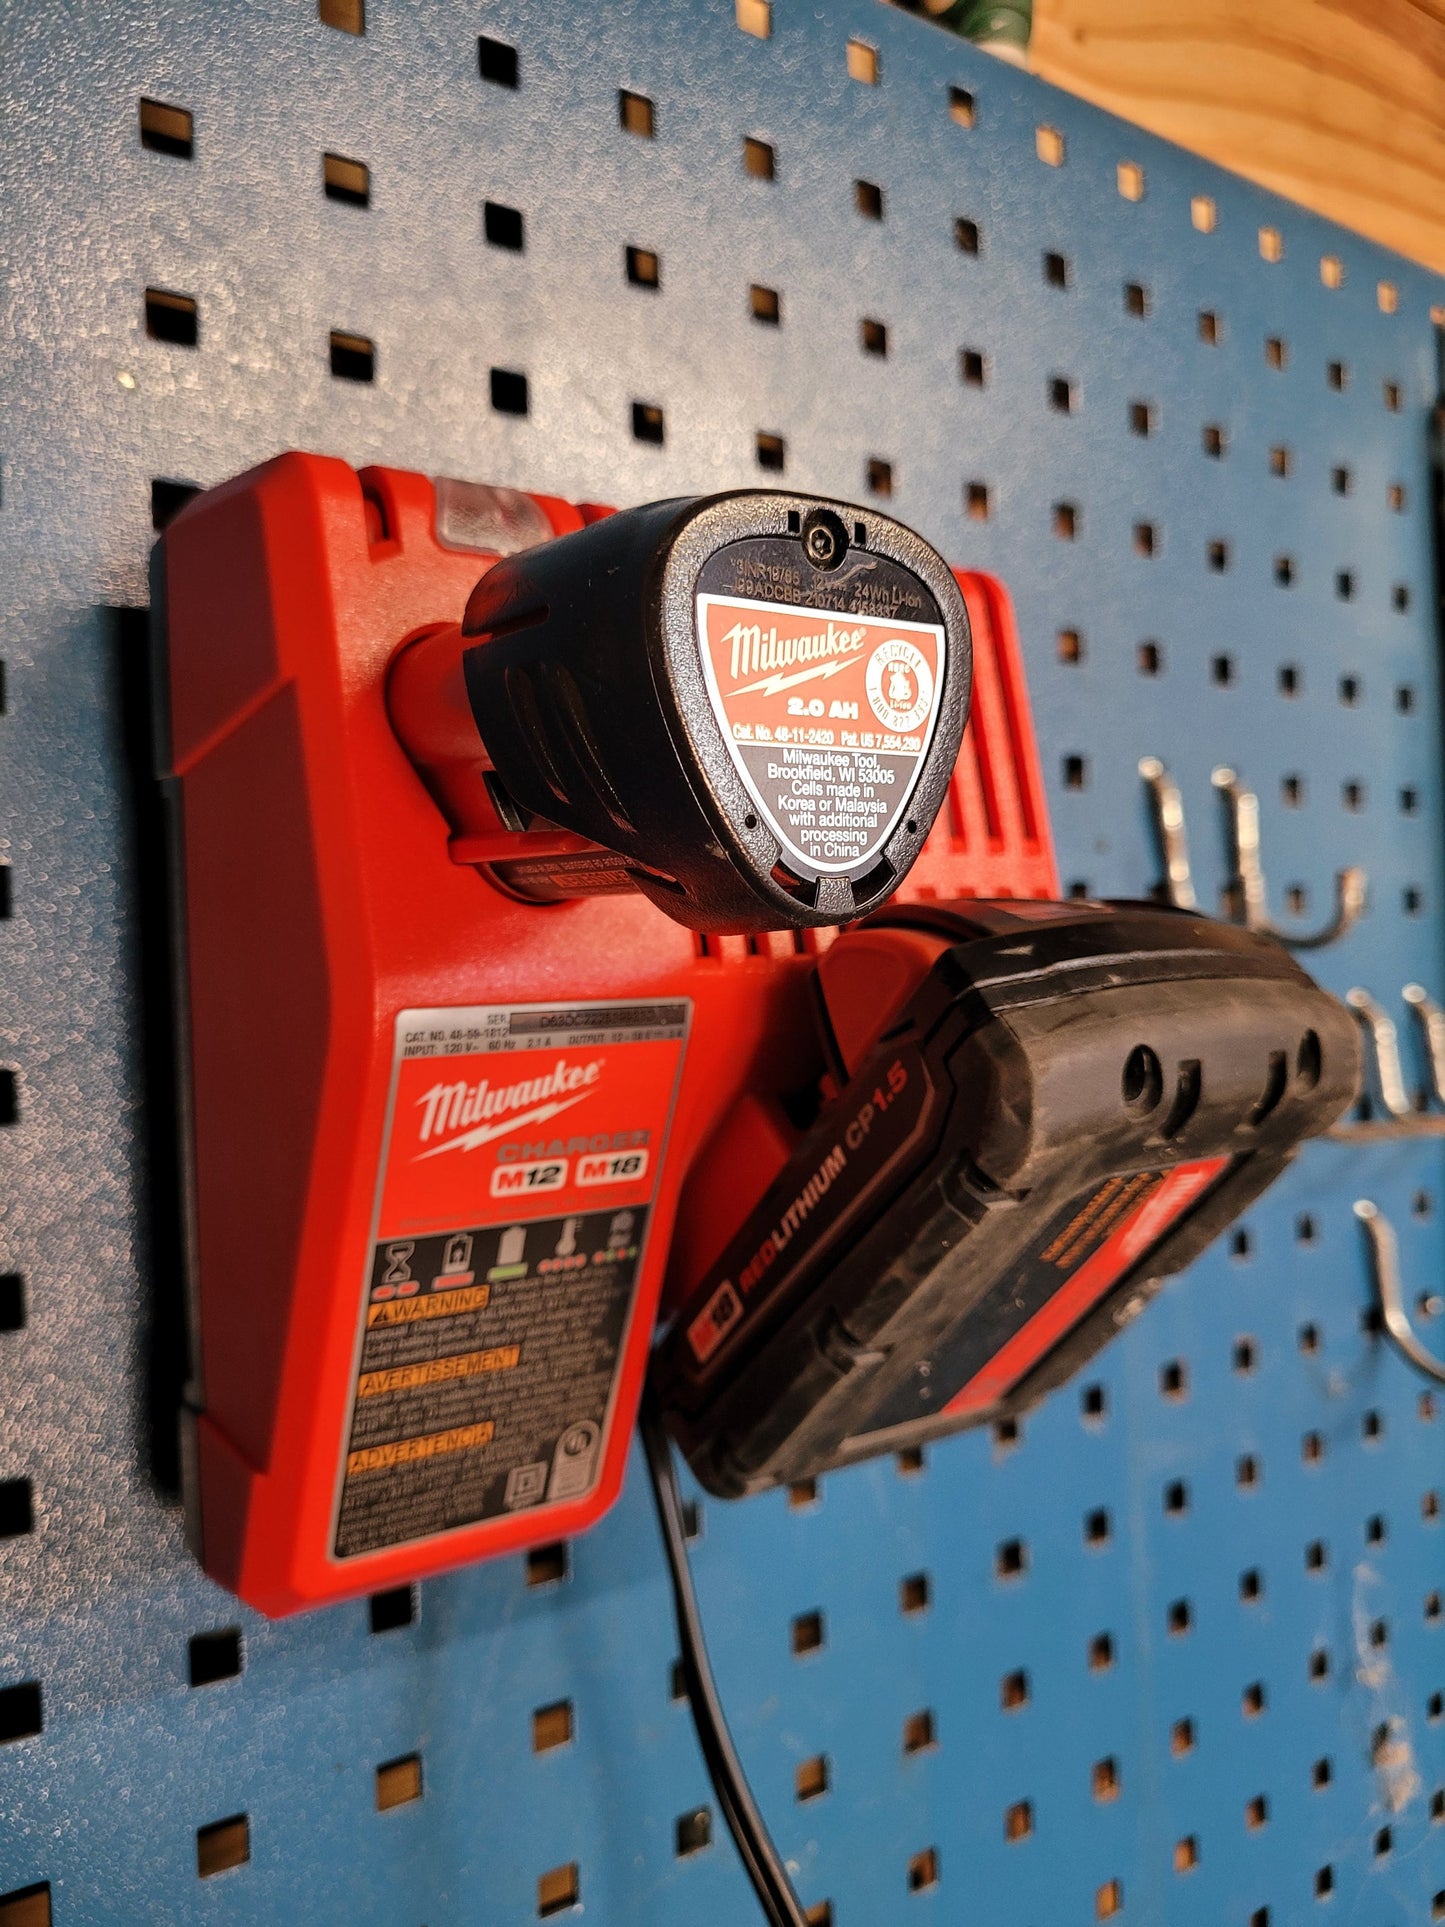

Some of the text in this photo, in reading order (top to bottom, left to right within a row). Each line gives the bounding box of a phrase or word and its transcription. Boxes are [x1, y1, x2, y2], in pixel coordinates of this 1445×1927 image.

[720, 621, 865, 680] Milwaukee
[787, 697, 859, 720] 2.0 AH
[733, 724, 753, 740] Cat.
[755, 726, 773, 741] No.
[774, 728, 834, 744] 48-11-2420
[841, 731, 858, 746] Pat.
[860, 733, 874, 747] US
[783, 749, 880, 769] Milwaukee Tool,
[767, 763, 895, 784] Brookfield, WI 53005
[792, 781, 875, 798] Cells made in
[778, 795, 888, 815] Korea or Malaysia
[789, 813, 878, 828] with additional
[801, 829, 868, 845] processing
[809, 842, 860, 857] in China
[415, 1058, 602, 1143] Milwaukee
[497, 1129, 653, 1163] CHARGER
[496, 1154, 643, 1190] M12 M18
[393, 1288, 489, 1319] WARNING
[362, 1346, 520, 1391] AVERTISSEMENT
